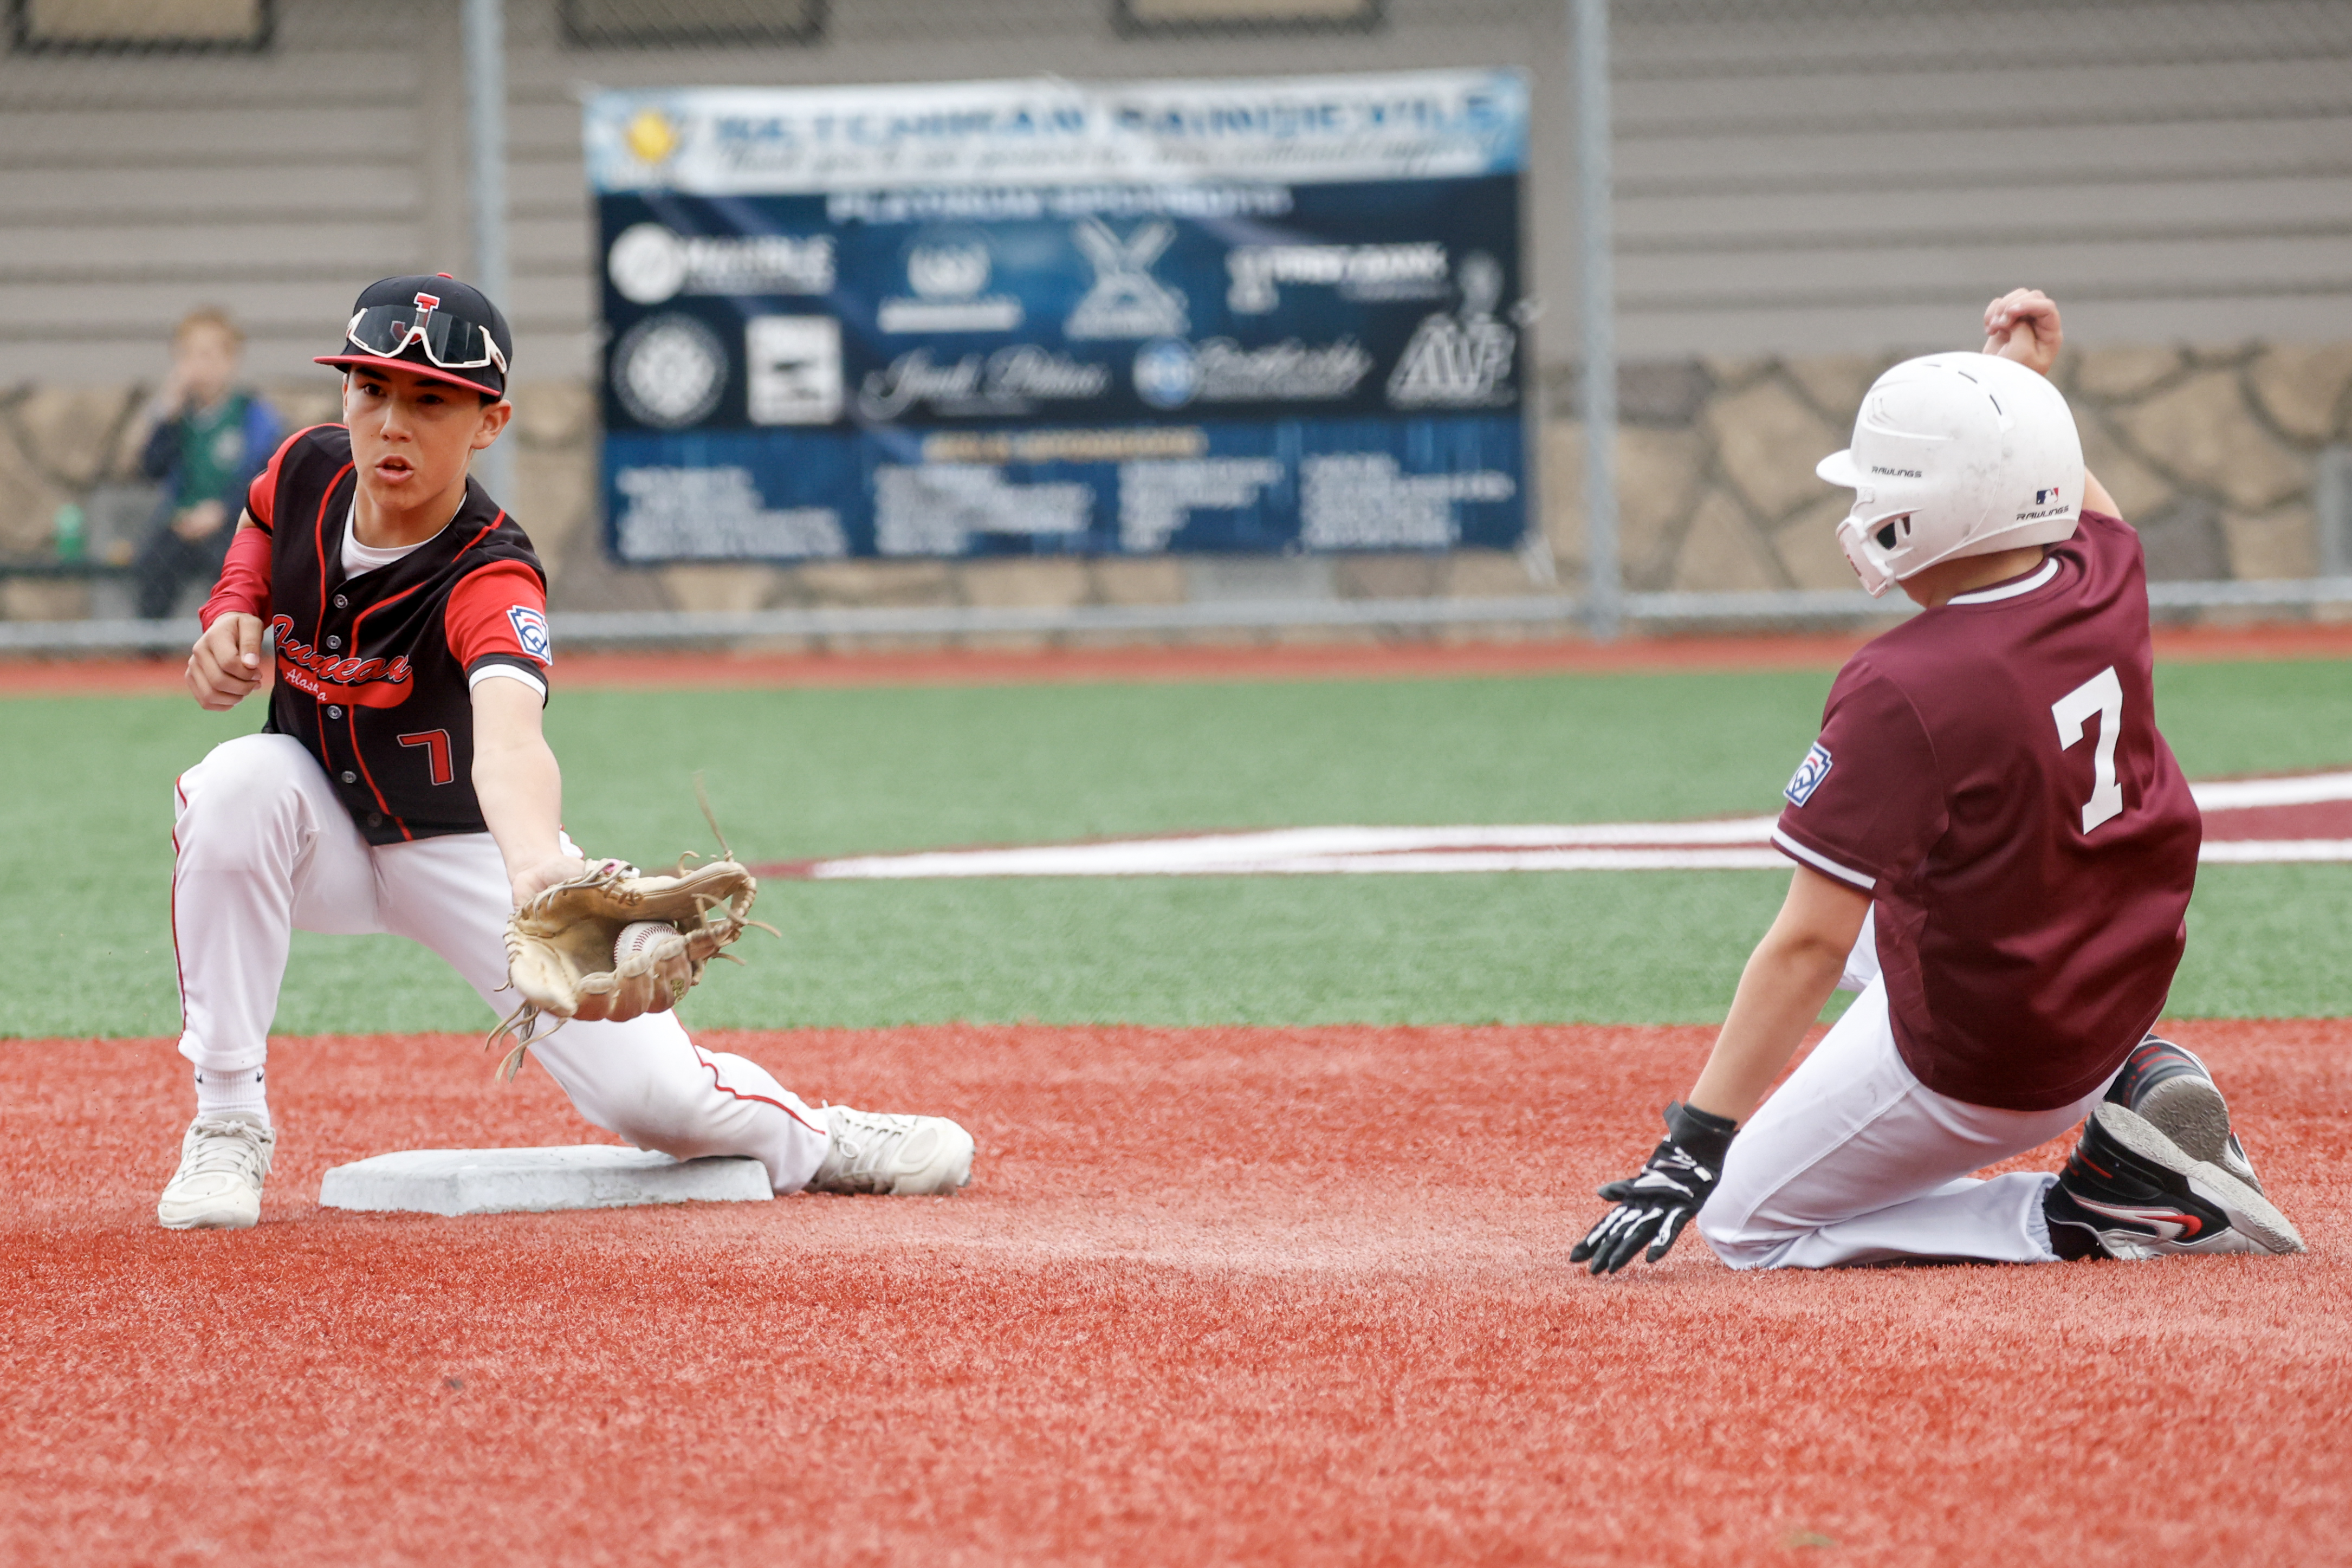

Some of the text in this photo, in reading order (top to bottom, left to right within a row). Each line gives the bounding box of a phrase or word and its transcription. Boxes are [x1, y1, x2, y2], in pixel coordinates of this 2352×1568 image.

[1871, 465, 1923, 478] RAWLINGS
[2016, 504, 2069, 521] RAWLINGS
[285, 668, 328, 701] Alaska
[397, 728, 454, 786] 7
[2051, 665, 2123, 835] 7
